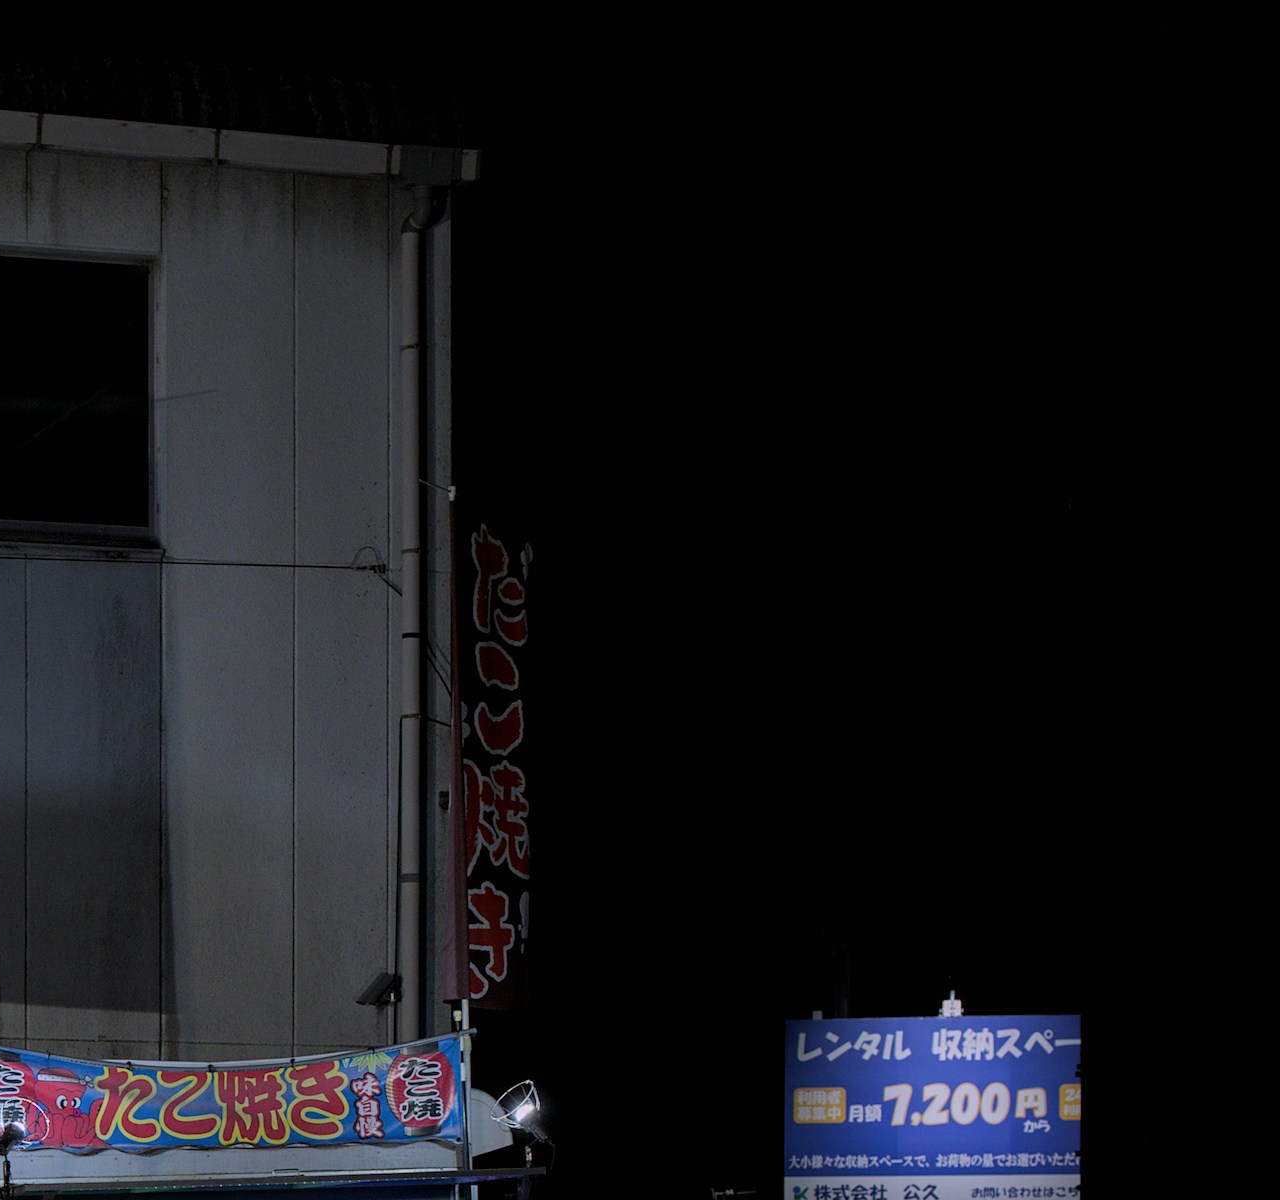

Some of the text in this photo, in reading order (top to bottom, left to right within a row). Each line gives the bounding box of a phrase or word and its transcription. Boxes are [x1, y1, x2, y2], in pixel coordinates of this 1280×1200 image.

[797, 1028, 1081, 1062] レンタル 収納スペー
[93, 1059, 351, 1145] たこ焼き
[351, 1072, 385, 1139] 味自慢
[399, 1057, 442, 1122] たこ焼
[848, 1082, 1051, 1133] 月額 7,200 円 から
[814, 1184, 939, 1200] 株式会社 公久
